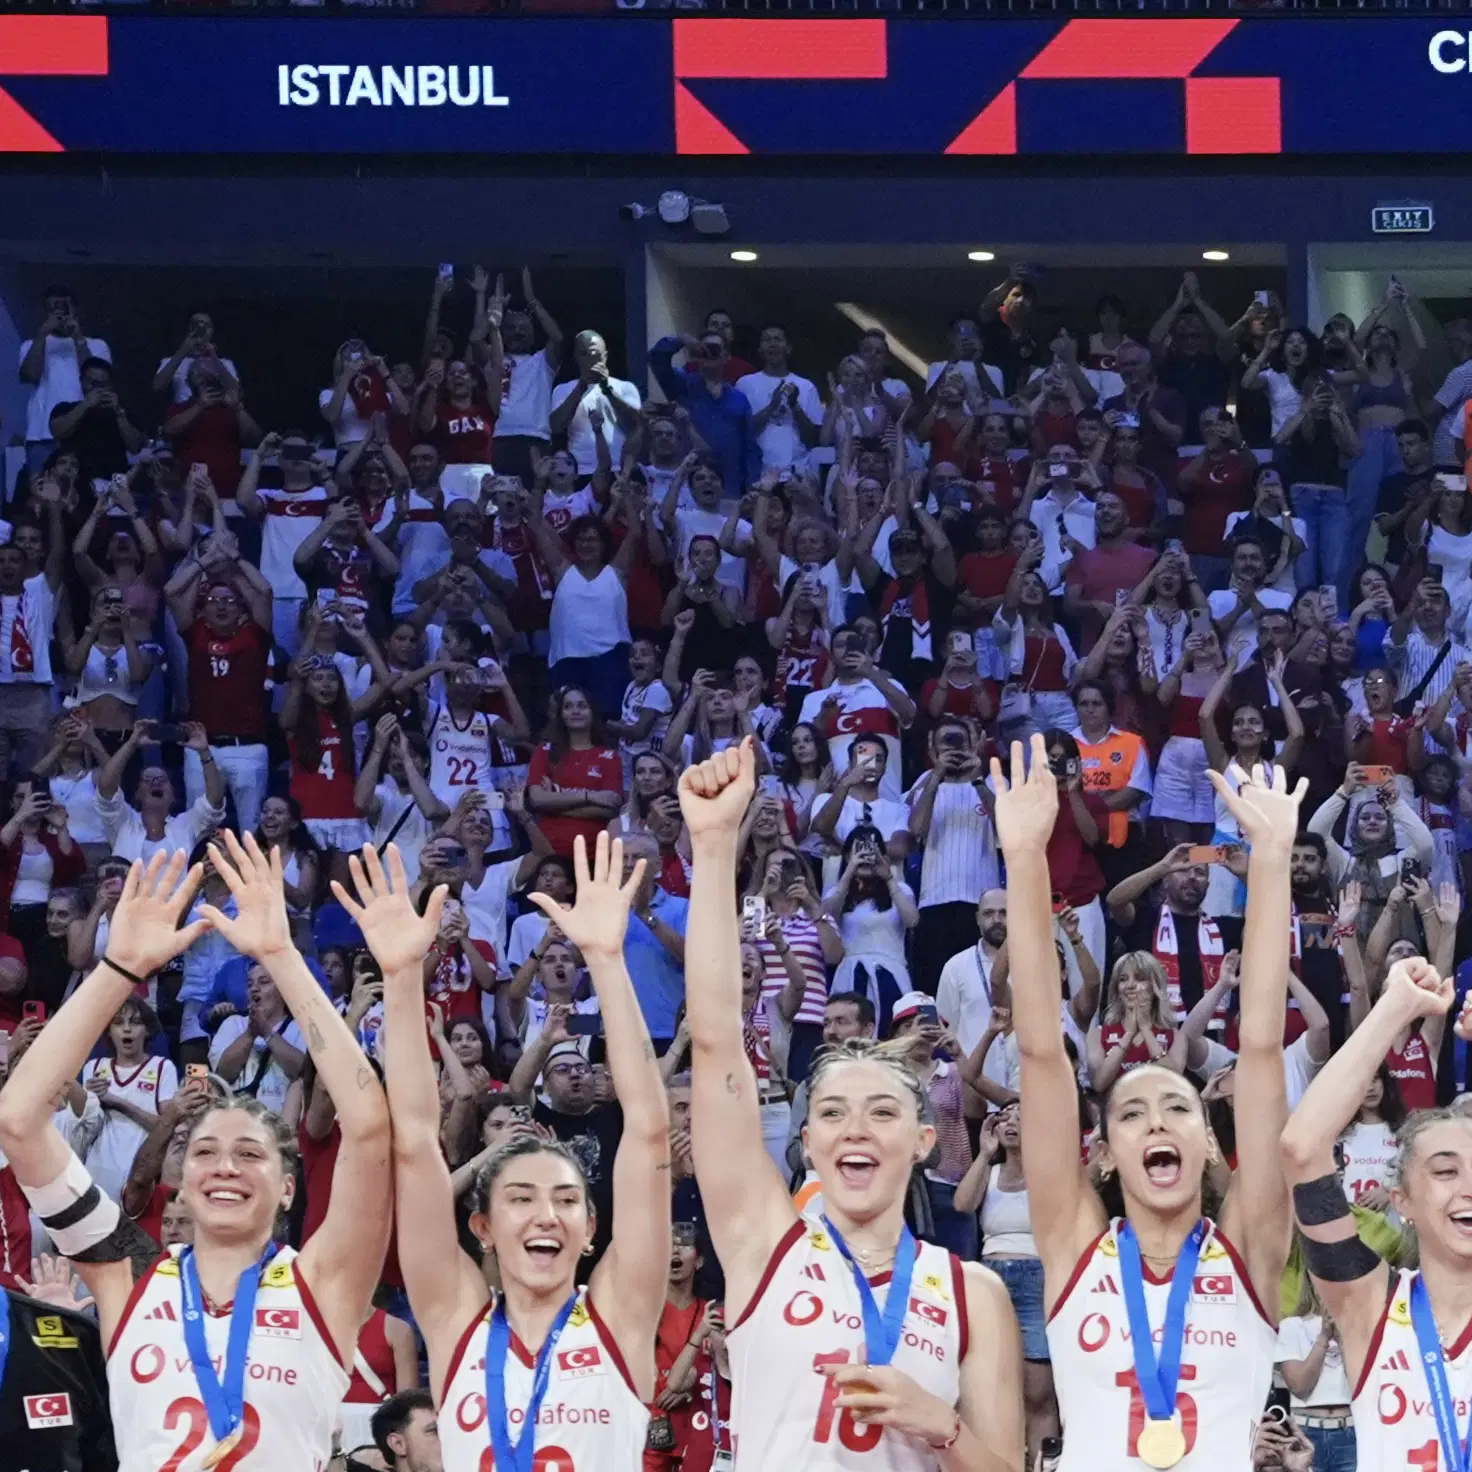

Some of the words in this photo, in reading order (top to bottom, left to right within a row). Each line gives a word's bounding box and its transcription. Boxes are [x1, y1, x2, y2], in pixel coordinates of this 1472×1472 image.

[278, 64, 510, 107] ISTANBUL
[1381, 211, 1423, 221] EXIT
[786, 657, 816, 687] 22
[317, 750, 335, 780] 4
[446, 757, 478, 785] 22
[44, 1319, 57, 1333] S
